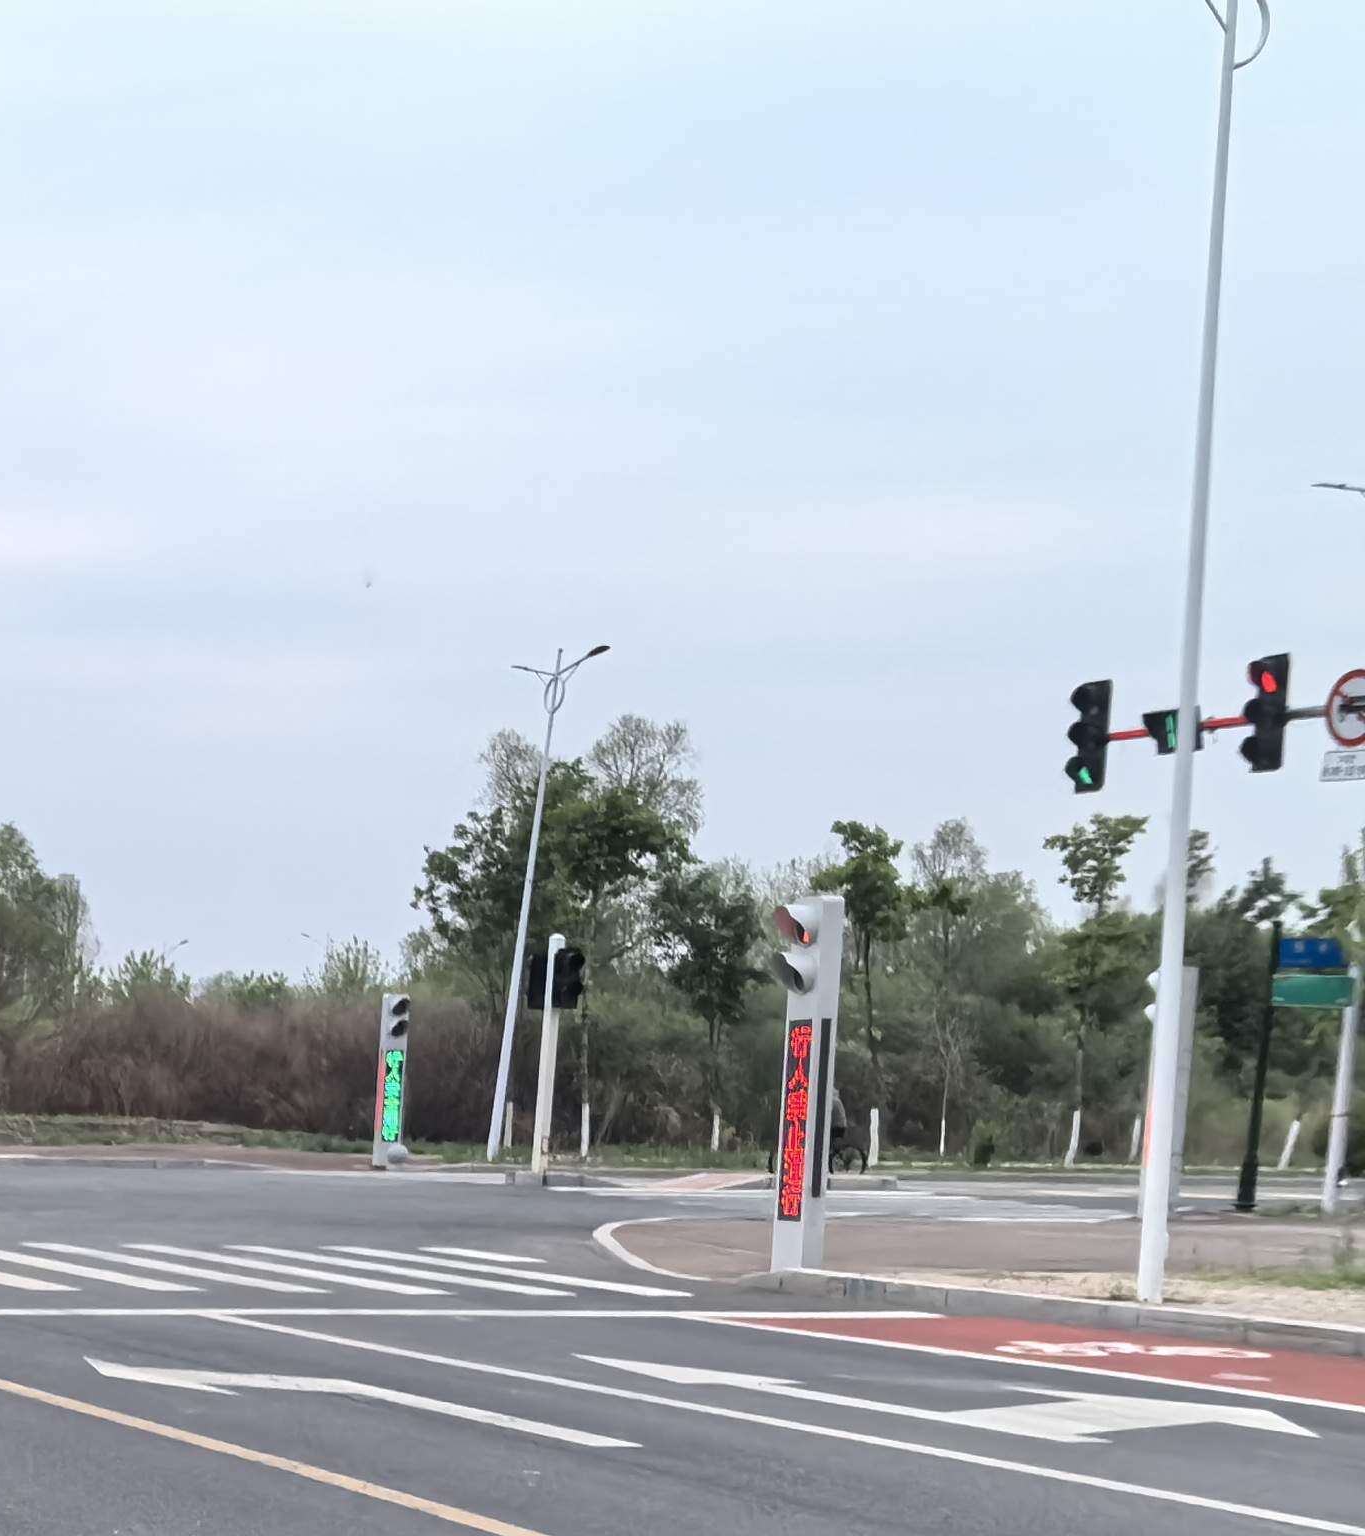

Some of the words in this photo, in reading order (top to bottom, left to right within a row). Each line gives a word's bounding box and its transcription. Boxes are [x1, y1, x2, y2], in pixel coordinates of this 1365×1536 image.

[781, 1025, 813, 1216] 行人禁止通行
